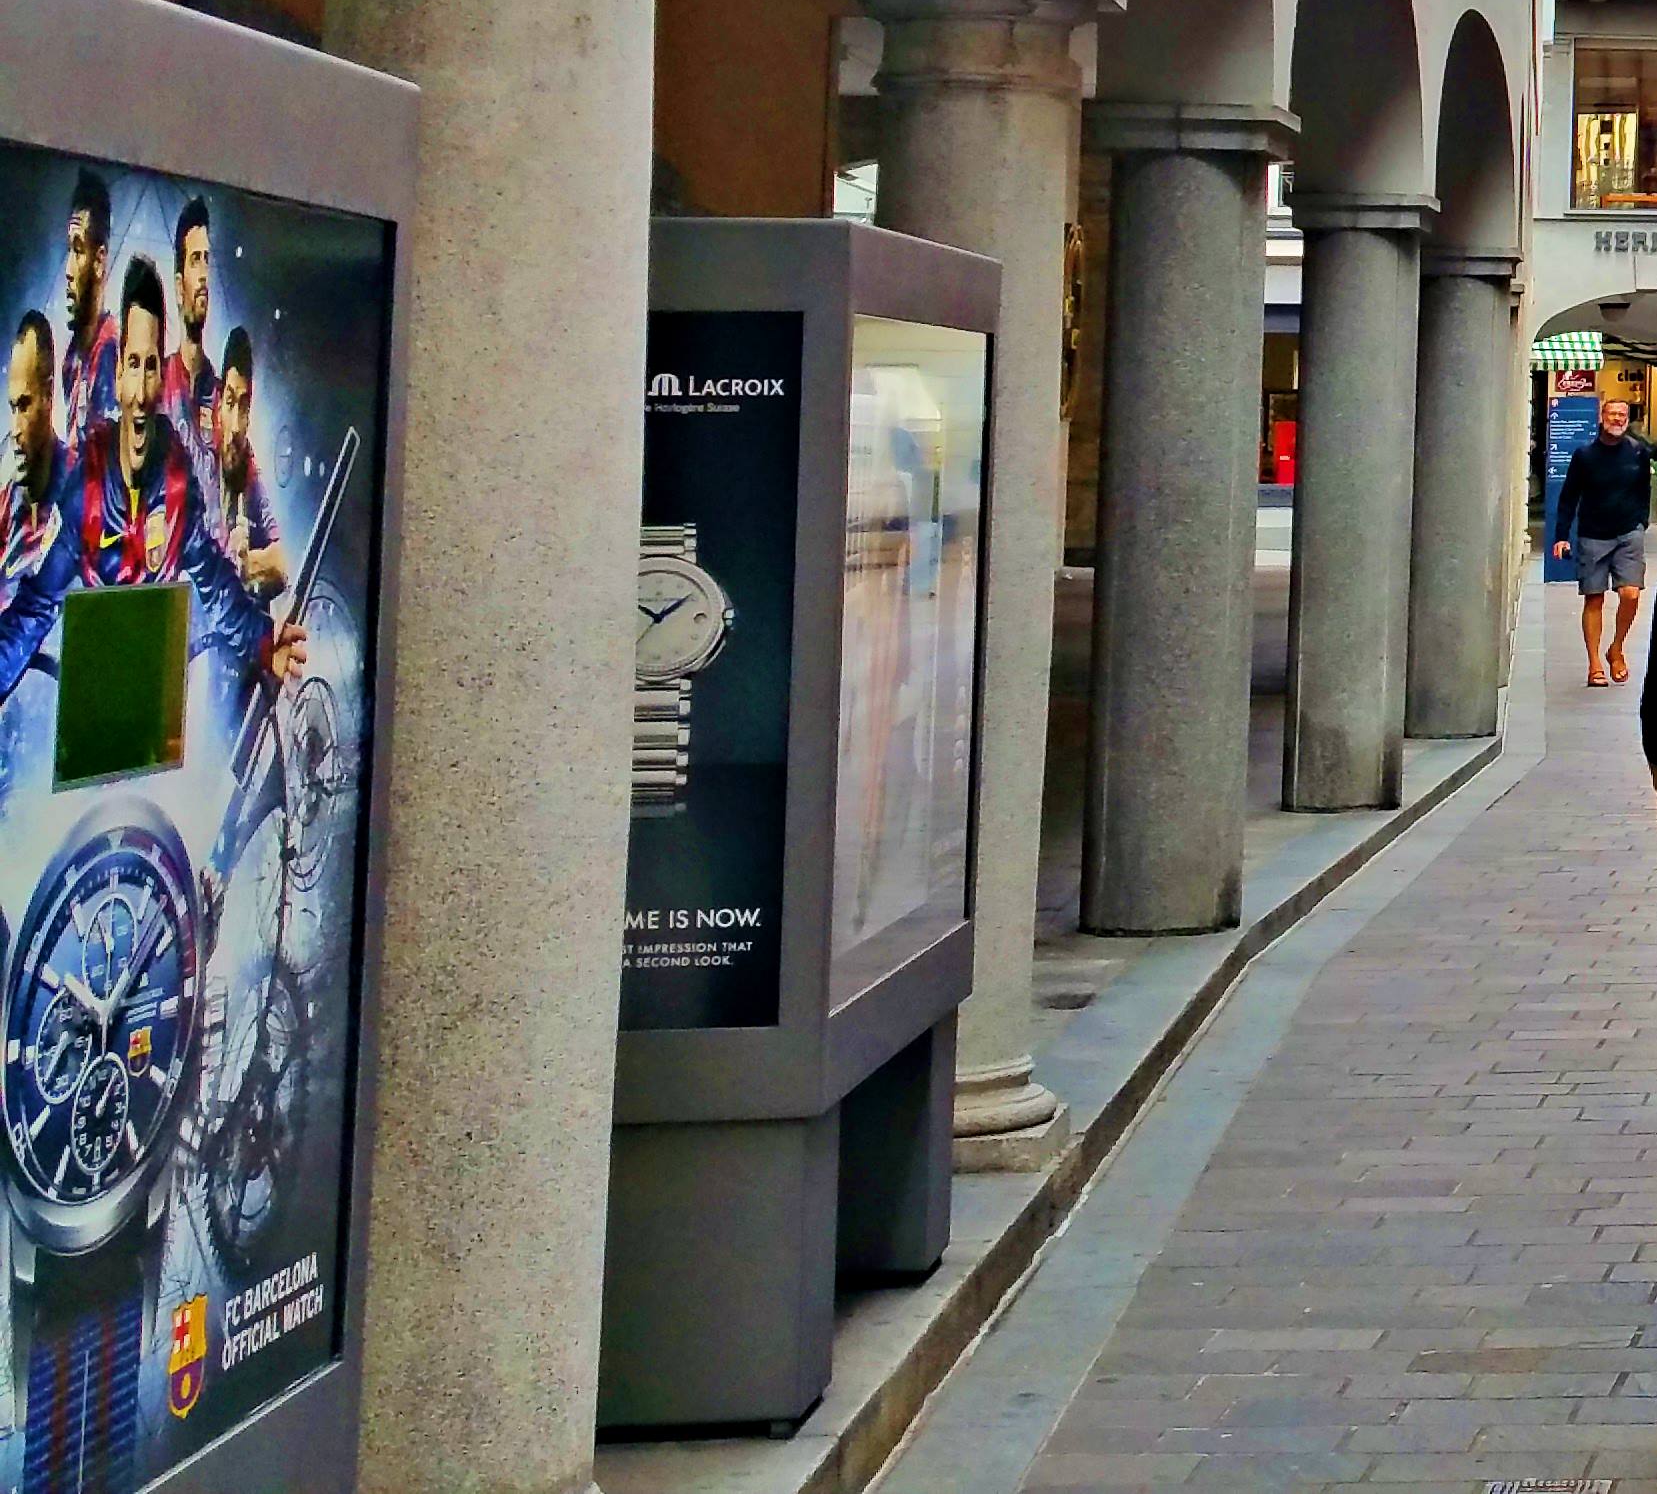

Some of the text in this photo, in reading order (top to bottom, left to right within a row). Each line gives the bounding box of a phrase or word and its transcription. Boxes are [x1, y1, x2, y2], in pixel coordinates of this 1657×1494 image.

[689, 375, 785, 396] LACROIX
[669, 909, 689, 929] IS
[696, 908, 762, 929] NOW.
[638, 942, 717, 955] IMPRESSION
[722, 941, 753, 952] THAT
[636, 956, 690, 968] SECOND
[225, 1252, 319, 1327] FC BARCELONA
[221, 1284, 324, 1371] OFFICIAL WATCH
